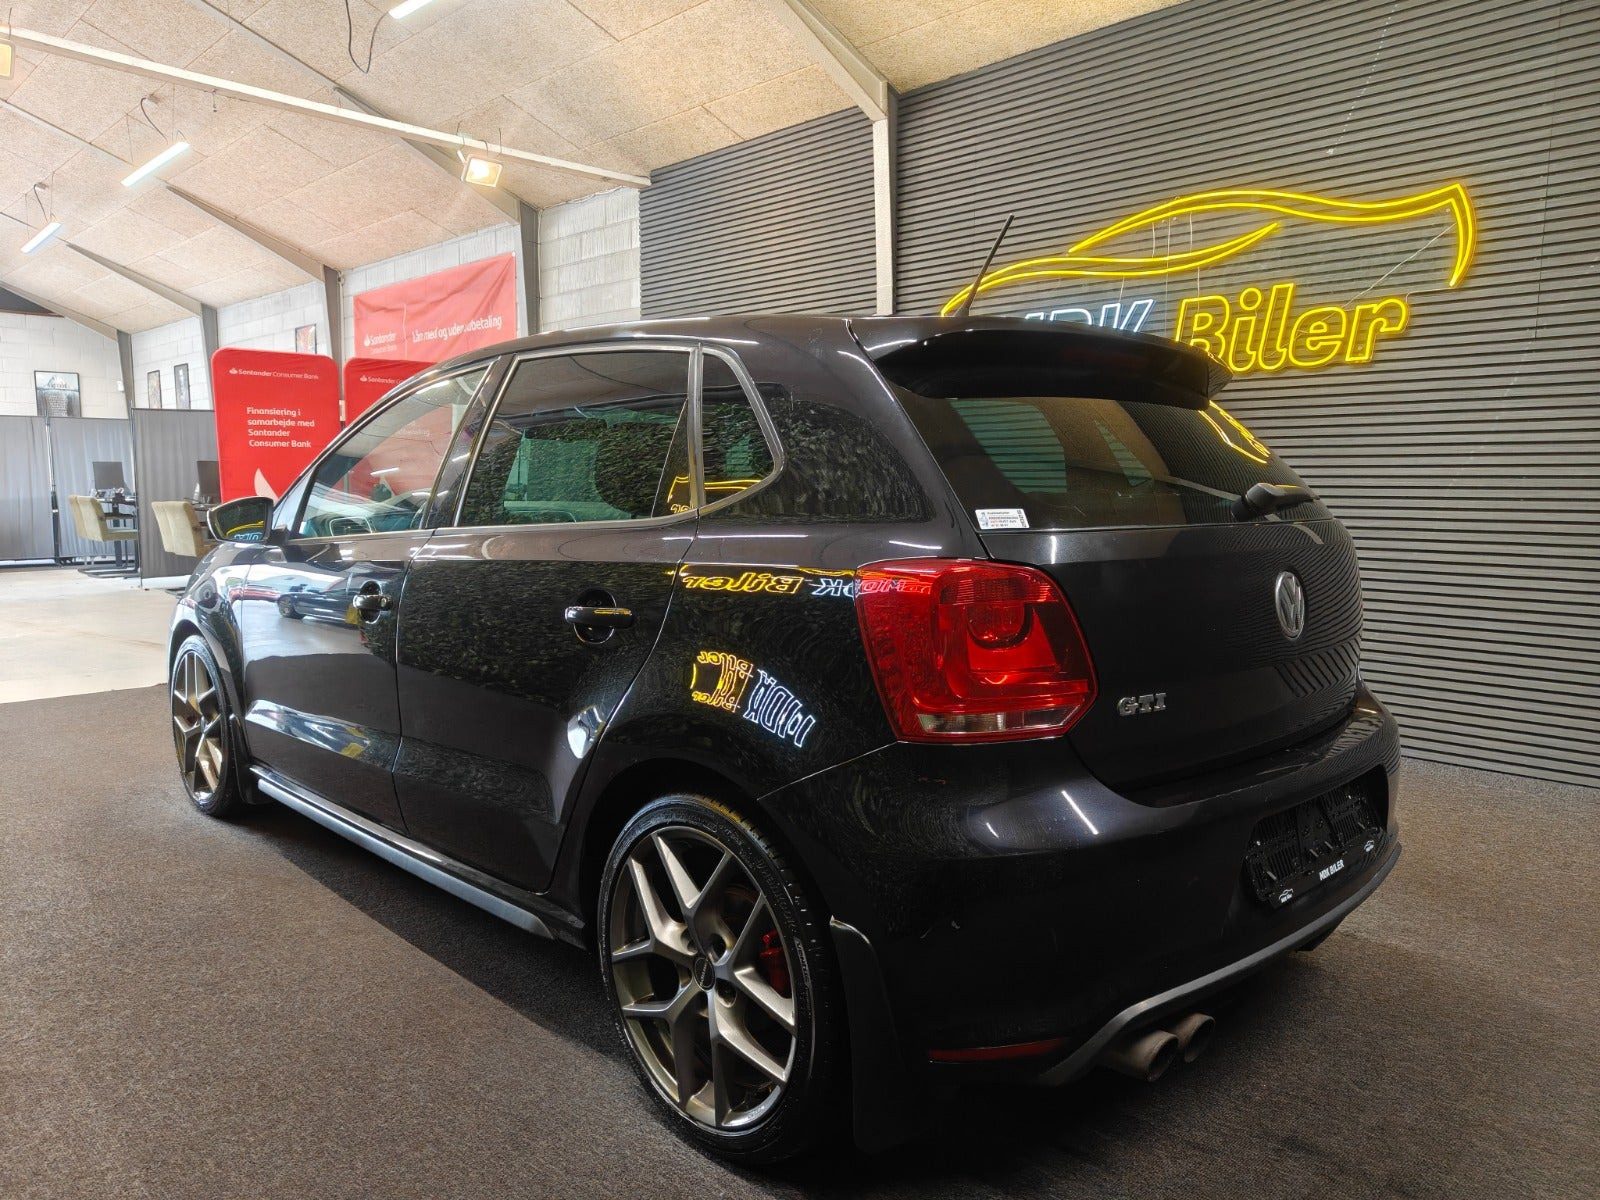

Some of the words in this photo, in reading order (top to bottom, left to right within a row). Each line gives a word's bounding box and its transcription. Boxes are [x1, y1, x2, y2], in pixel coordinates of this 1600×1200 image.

[1175, 282, 1408, 372] Biler
[423, 328, 438, 340] med
[438, 329, 448, 340] og
[370, 333, 397, 346] Santander
[238, 368, 272, 377] Santander
[368, 376, 396, 384] Santander
[246, 407, 297, 417] Finansiering
[247, 418, 296, 428] samarbejde
[297, 419, 315, 427] med
[248, 428, 291, 437] Santander
[249, 439, 290, 447] Consumer
[291, 440, 311, 448] Bank
[1117, 692, 1167, 717] GTI
[1329, 859, 1345, 875] BILER
